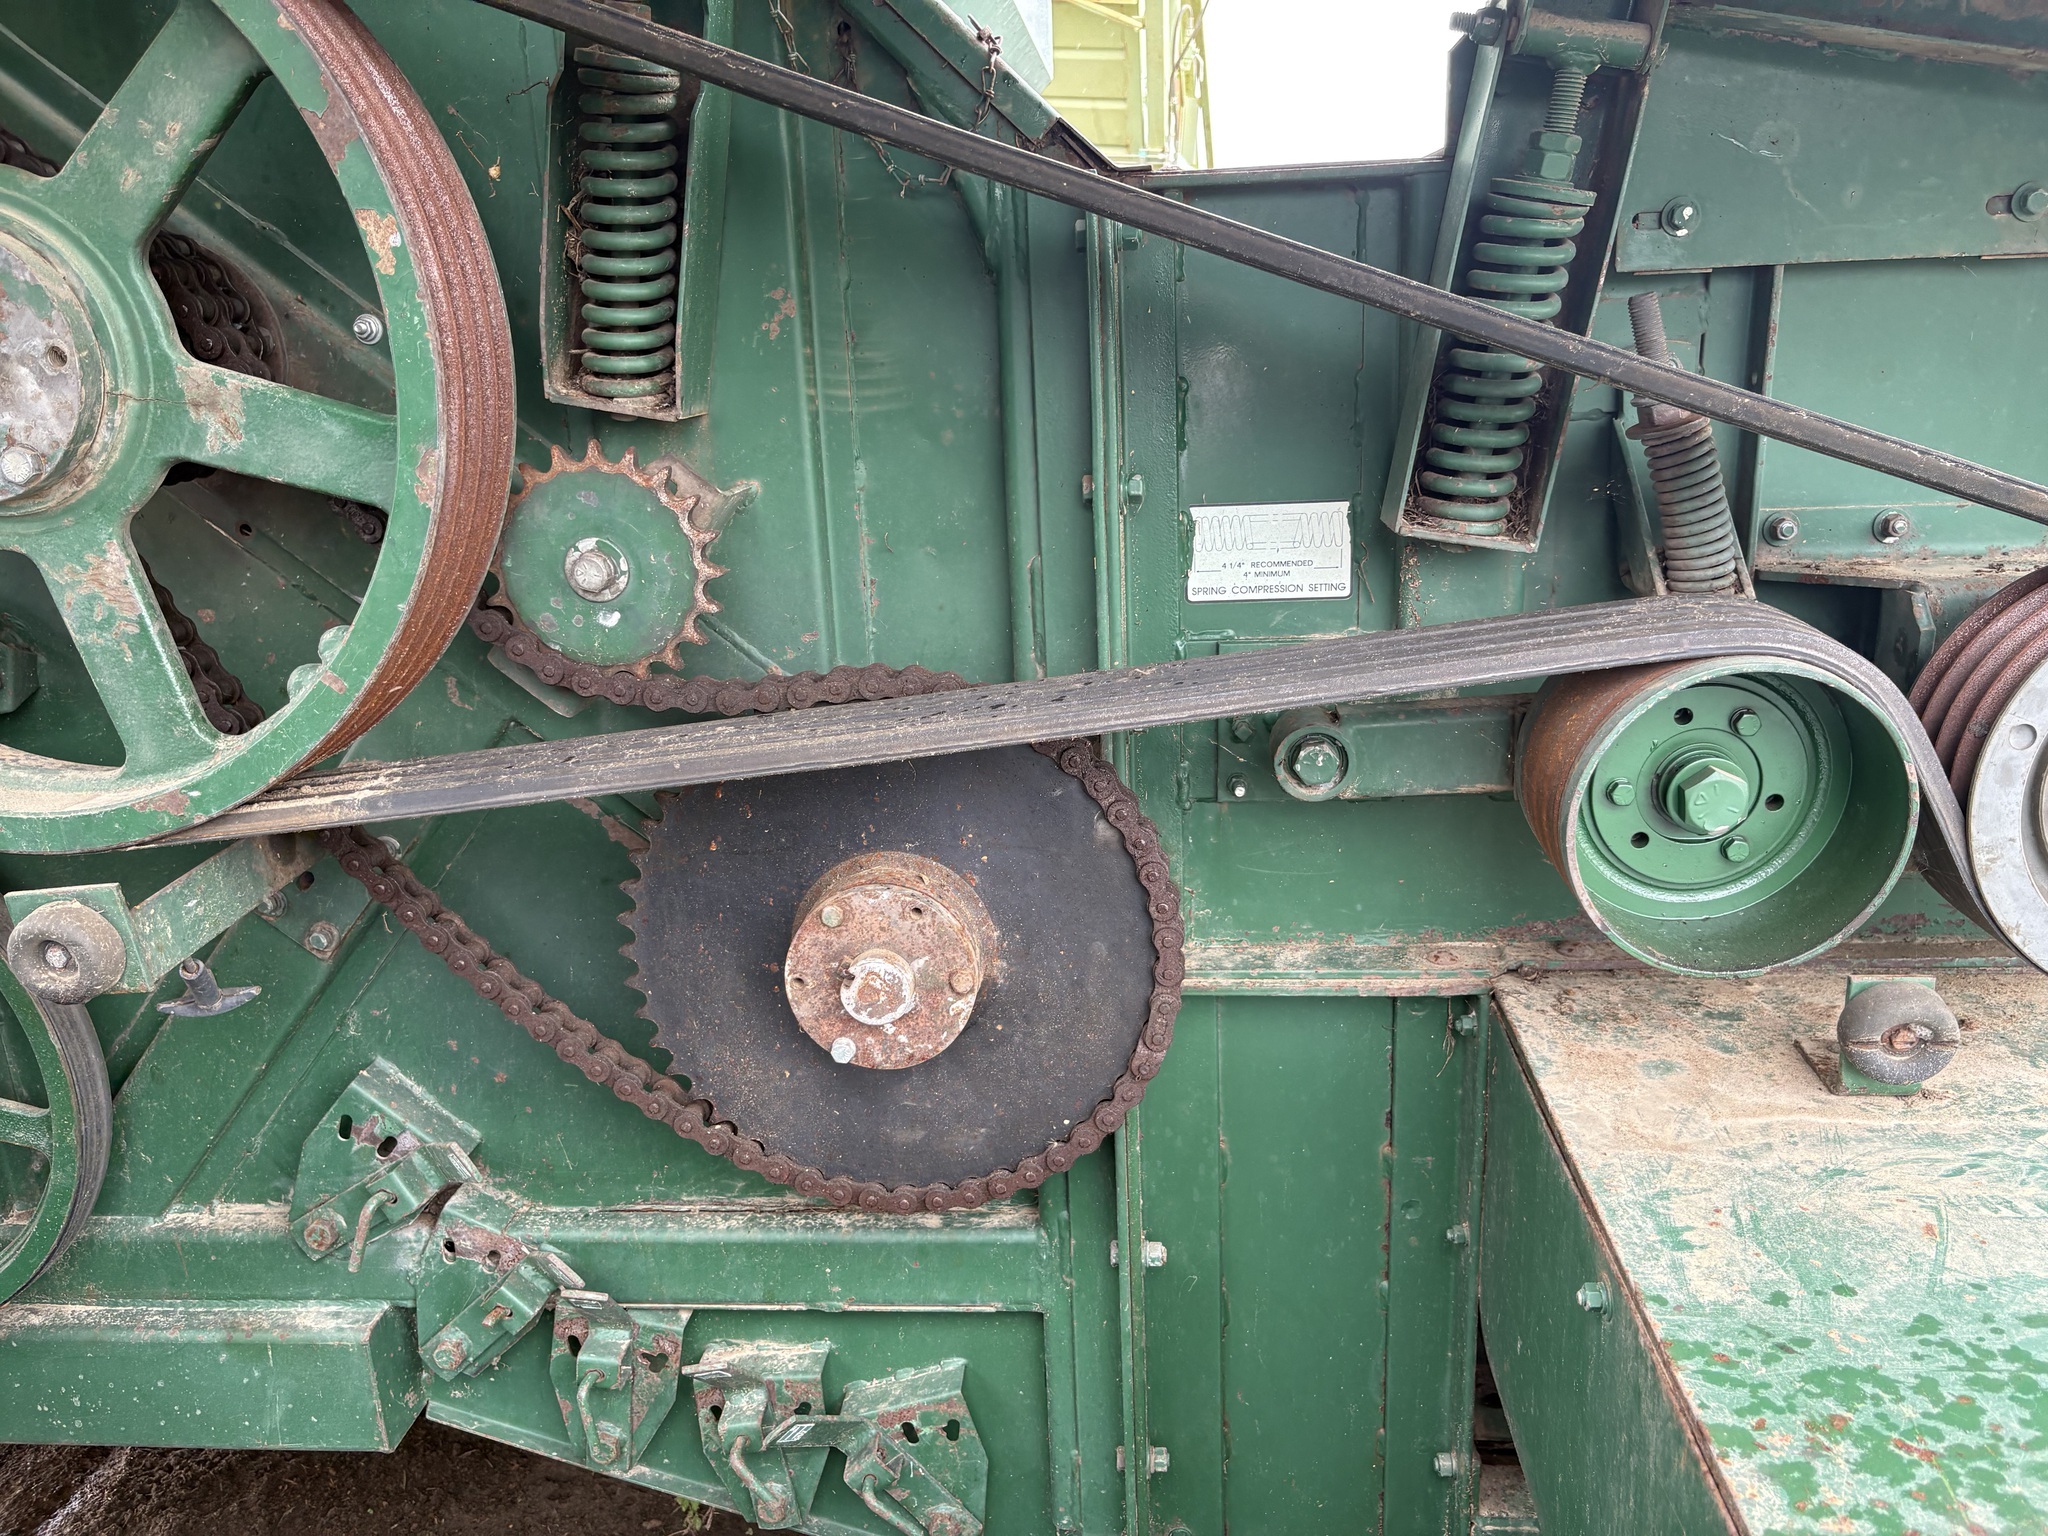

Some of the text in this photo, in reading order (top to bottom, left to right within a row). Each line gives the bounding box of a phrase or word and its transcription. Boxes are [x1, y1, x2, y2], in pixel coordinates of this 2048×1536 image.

[1250, 559, 1314, 568] RECOMMENDED
[1254, 570, 1291, 578] MINIMUM
[1191, 582, 1347, 596] SPRING COMPRESSION SETTING
